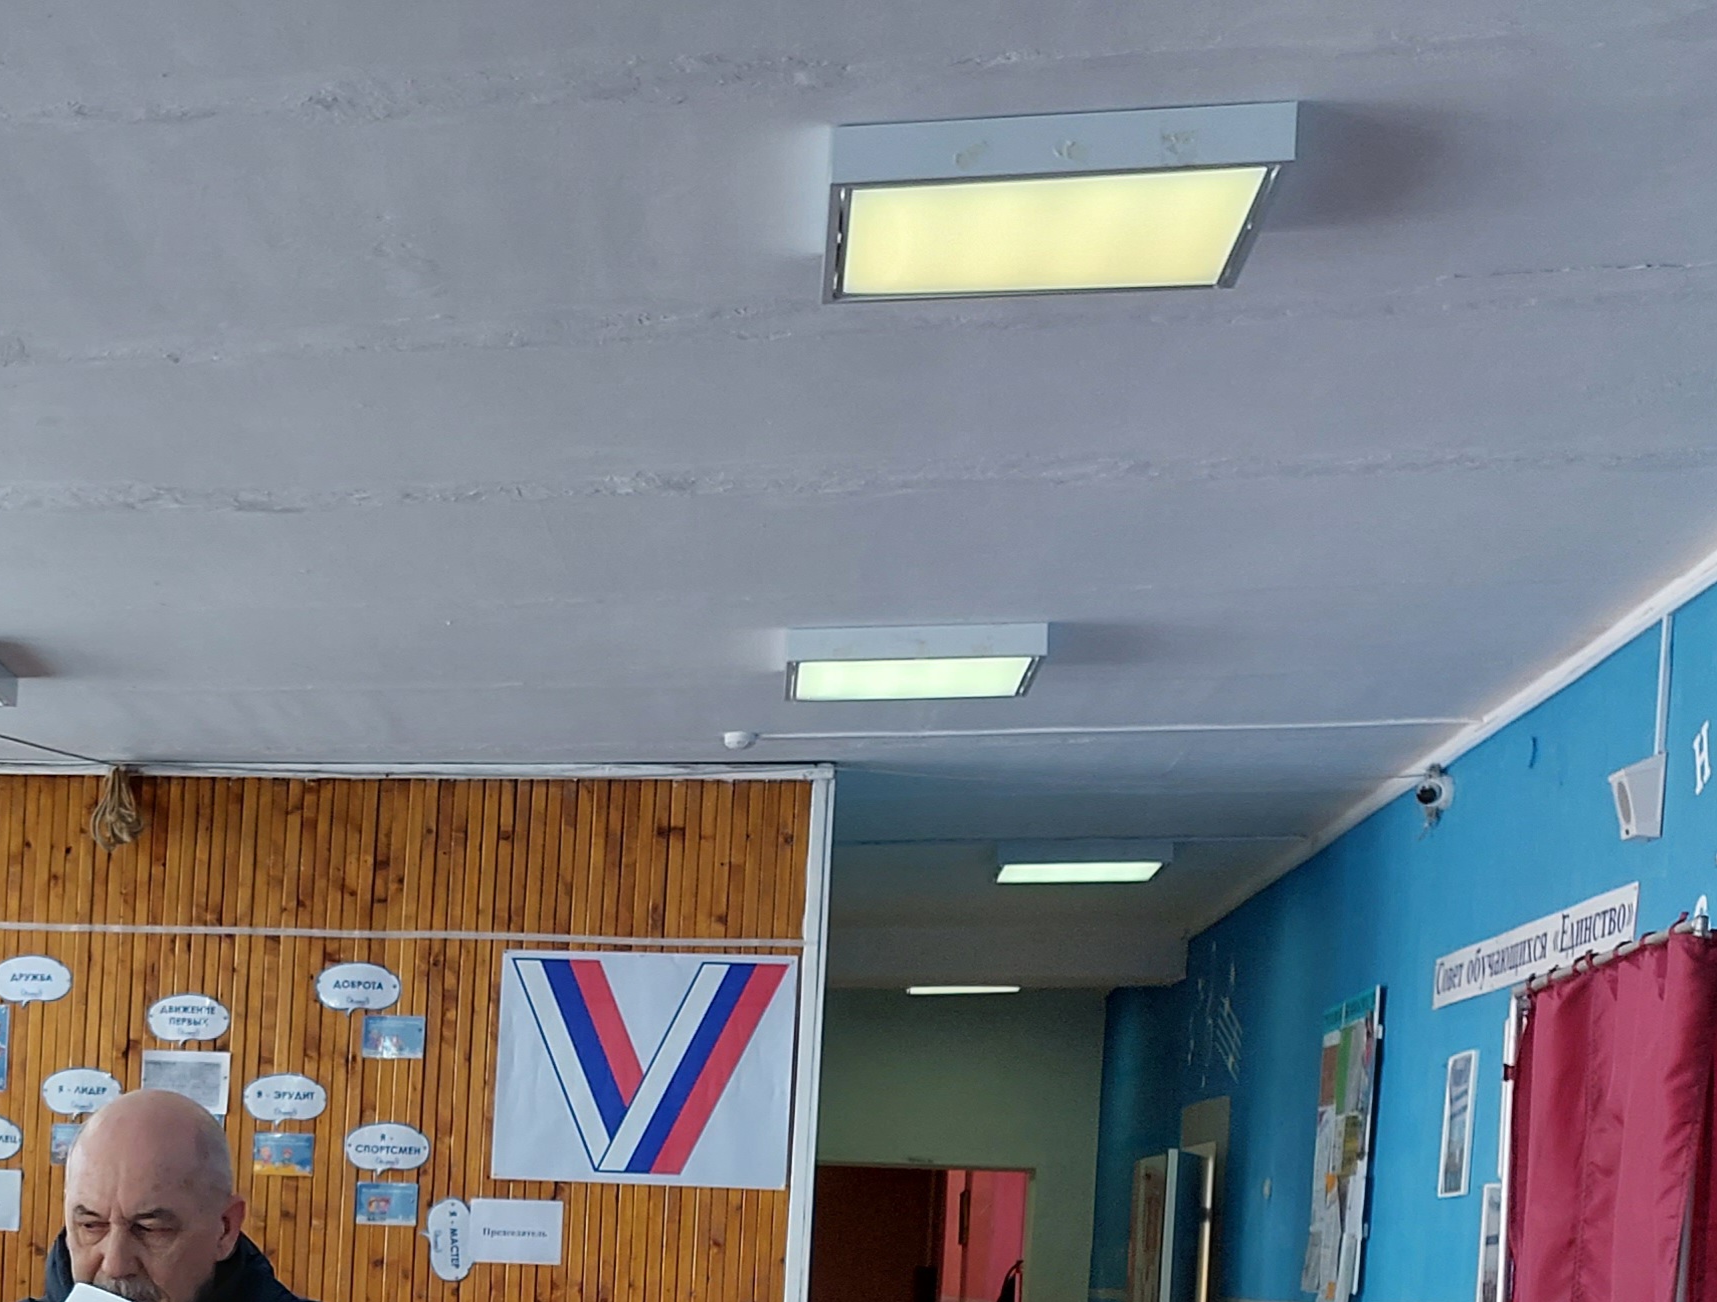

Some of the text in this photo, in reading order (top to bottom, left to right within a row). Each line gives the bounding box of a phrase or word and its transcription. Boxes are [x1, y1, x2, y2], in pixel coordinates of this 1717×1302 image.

[1436, 961, 1464, 995] Совет
[1466, 932, 1548, 991] обучающихся
[9, 972, 54, 983] ДРУЖБА
[333, 979, 384, 991] ДОБРОТА
[159, 1005, 217, 1016] ДВИЖЕНИЕ
[168, 1016, 209, 1028] ПЕРВЫХ
[74, 1086, 108, 1096] ЛИДЕР
[273, 1090, 316, 1101] ЭРУДИТ
[355, 1143, 421, 1155] СПОРТСМЕН
[449, 1228, 460, 1269] МАСТЕР
